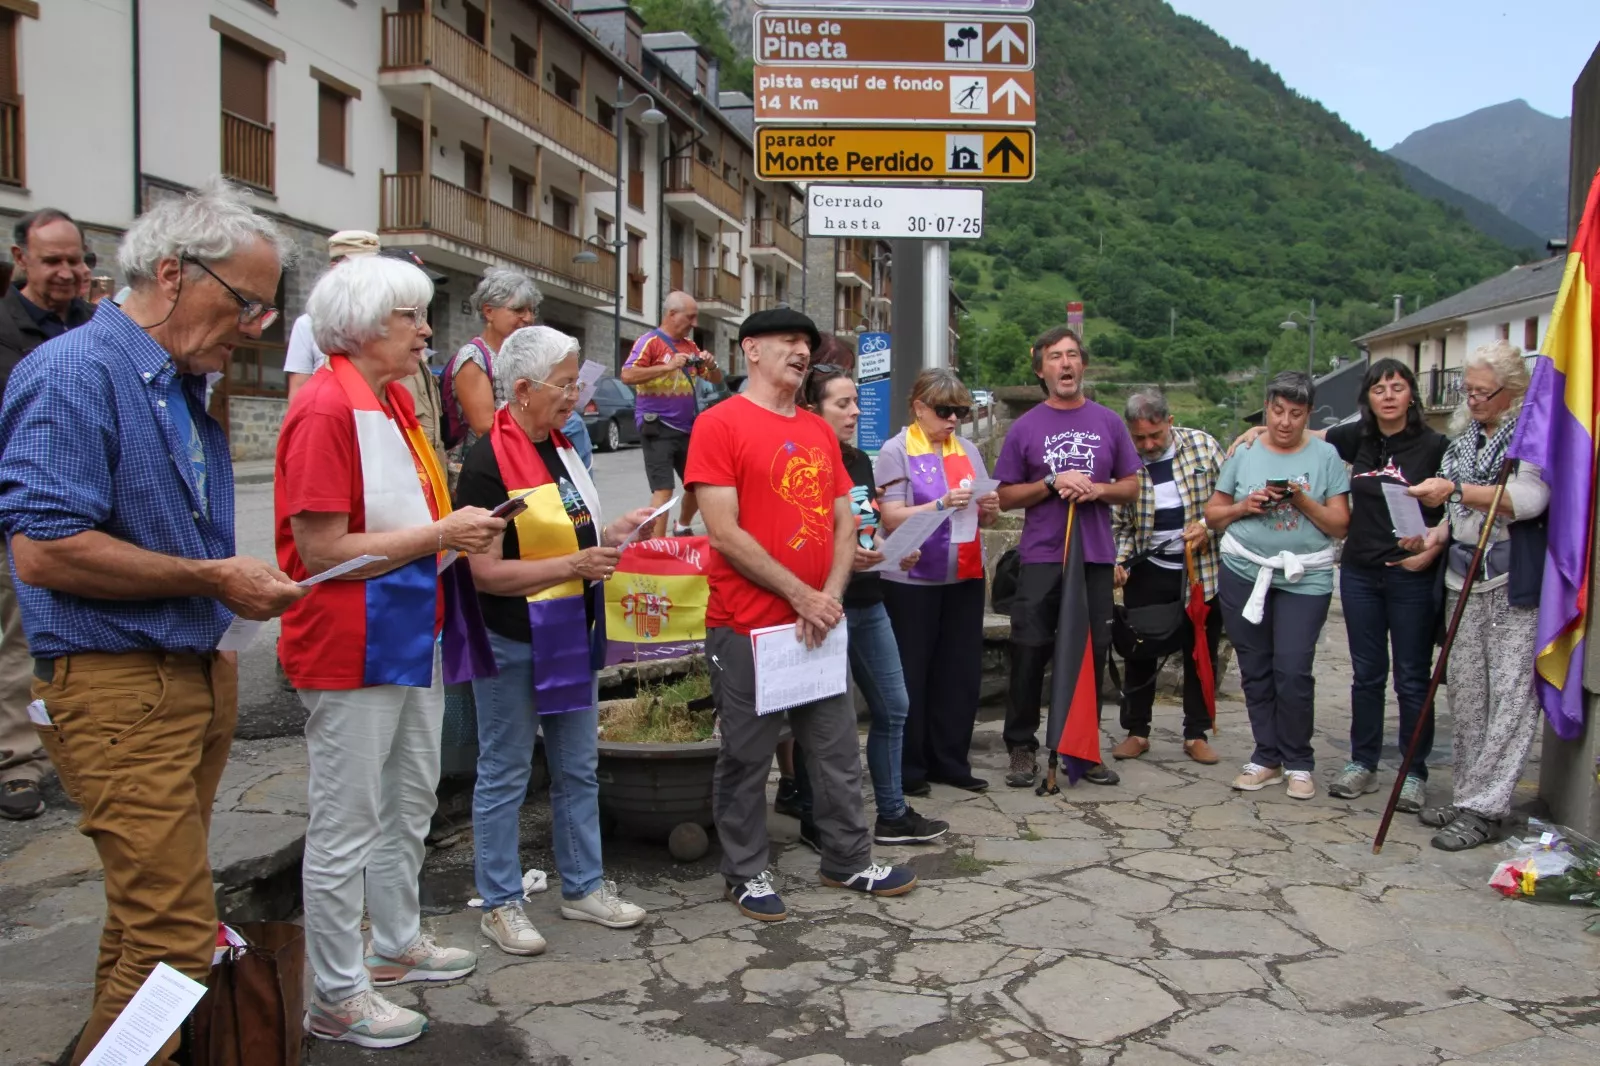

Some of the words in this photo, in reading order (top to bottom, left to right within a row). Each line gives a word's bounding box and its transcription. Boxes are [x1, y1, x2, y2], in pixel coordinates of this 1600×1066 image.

[765, 20, 811, 35] Valle
[818, 21, 841, 35] de
[764, 37, 847, 59] Pineta
[759, 74, 803, 91] pista
[811, 75, 859, 92] esquí
[865, 76, 887, 90] de
[893, 76, 943, 92] fondo
[760, 95, 781, 110] 14
[790, 96, 819, 111] Km
[765, 134, 835, 150] parador
[765, 152, 839, 172] Monte
[846, 151, 934, 173] Perdido
[813, 194, 883, 209] Cerrado
[824, 216, 881, 231] hasta
